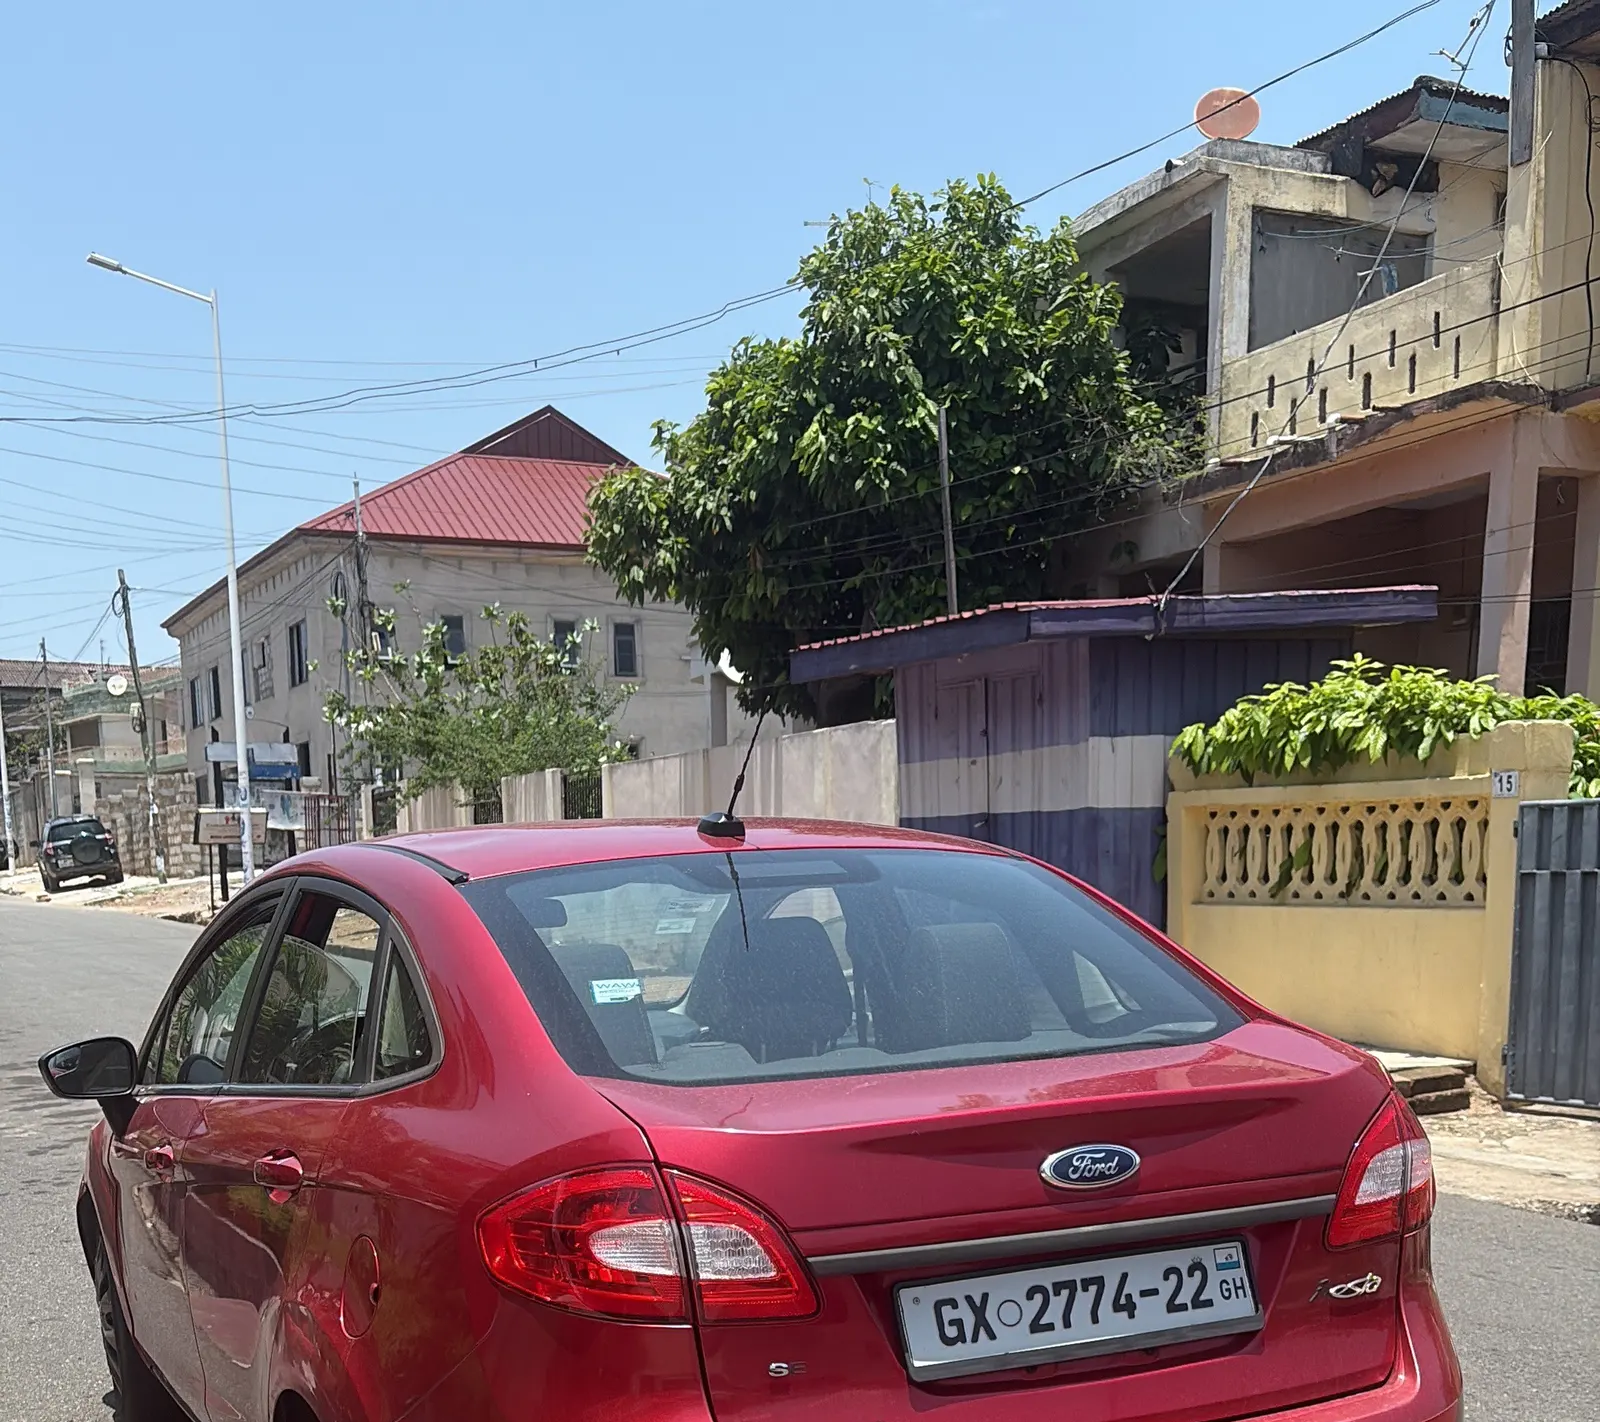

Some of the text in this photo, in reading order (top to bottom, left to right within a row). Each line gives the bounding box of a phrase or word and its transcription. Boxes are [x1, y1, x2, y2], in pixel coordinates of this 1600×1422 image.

[1498, 775, 1513, 792] 15
[1068, 1152, 1119, 1179] Ford
[1219, 1277, 1247, 1300] GH
[1309, 1272, 1382, 1302] Festa
[933, 1266, 1214, 1346] GX 2774-22
[768, 1361, 807, 1377] SE
